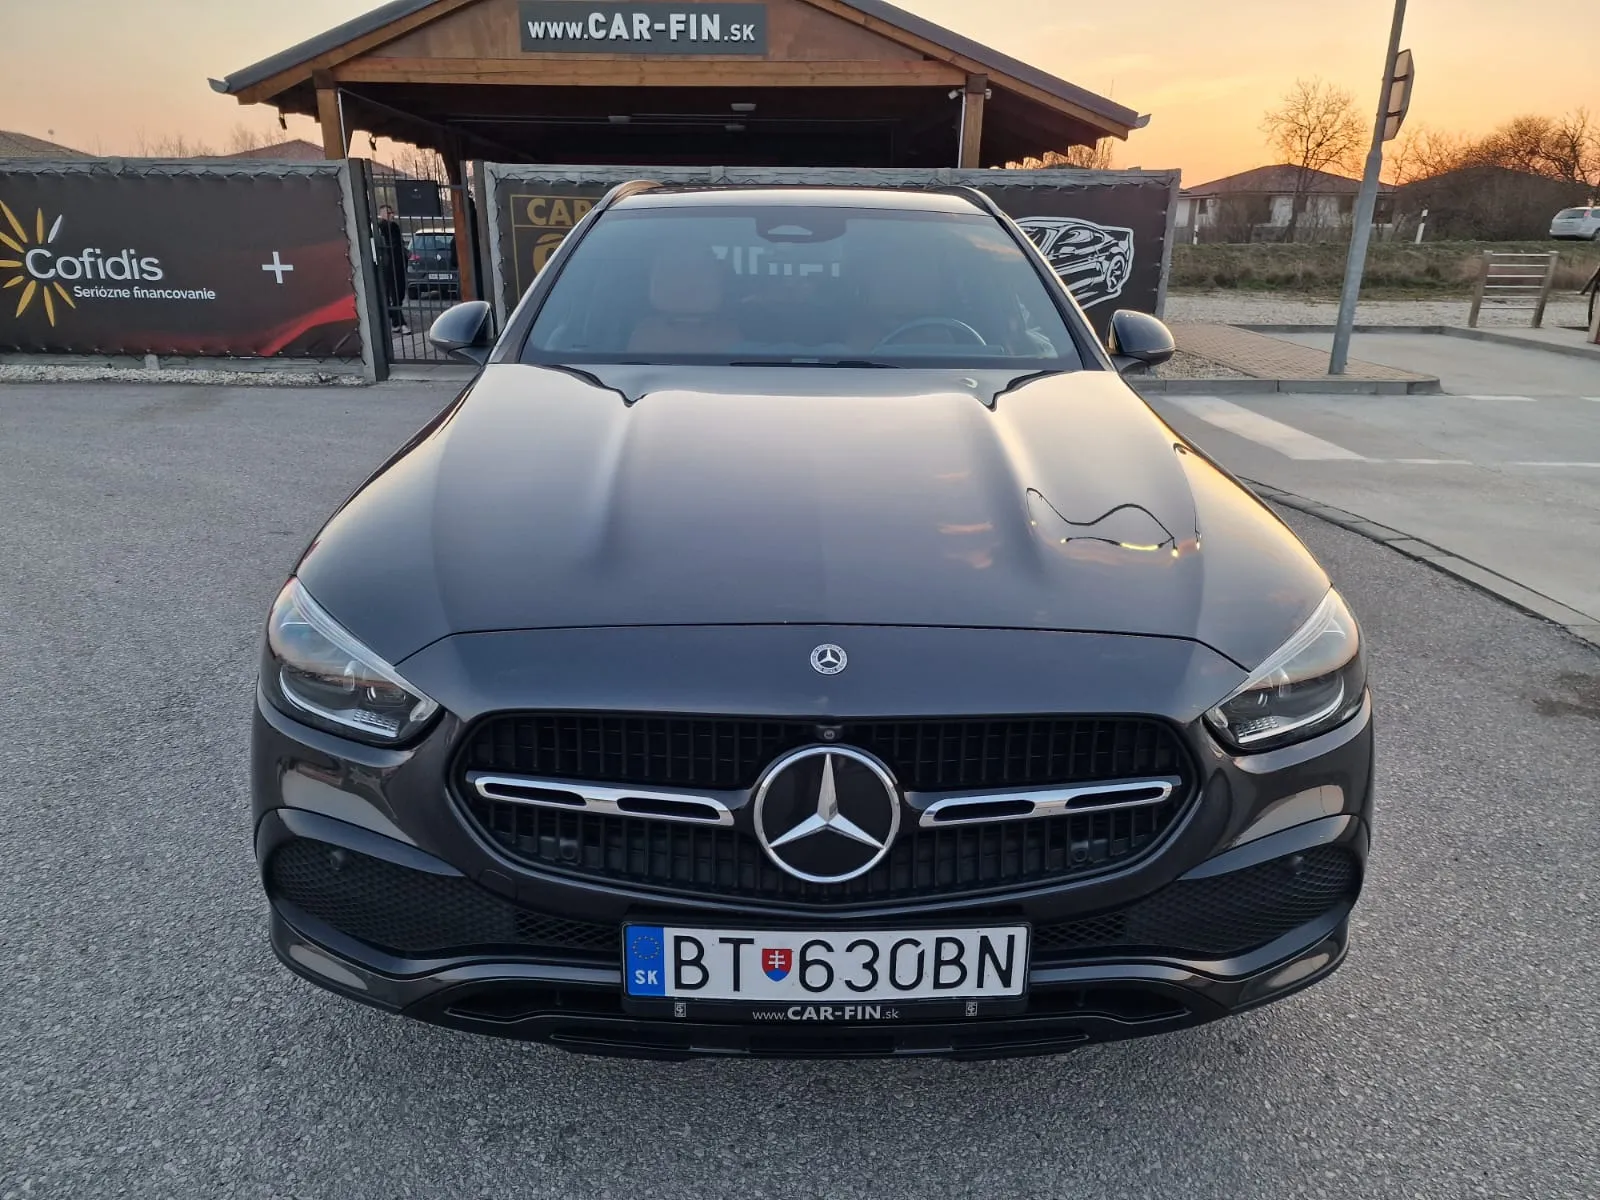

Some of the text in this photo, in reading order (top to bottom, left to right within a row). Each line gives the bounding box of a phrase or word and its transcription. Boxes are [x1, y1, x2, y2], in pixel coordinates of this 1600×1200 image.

[25, 247, 163, 281] Cofidis
[73, 285, 216, 300] Seriózne financovanie
[634, 969, 658, 985] SK
[752, 1005, 900, 1020] www.CAR-FIN.sk
